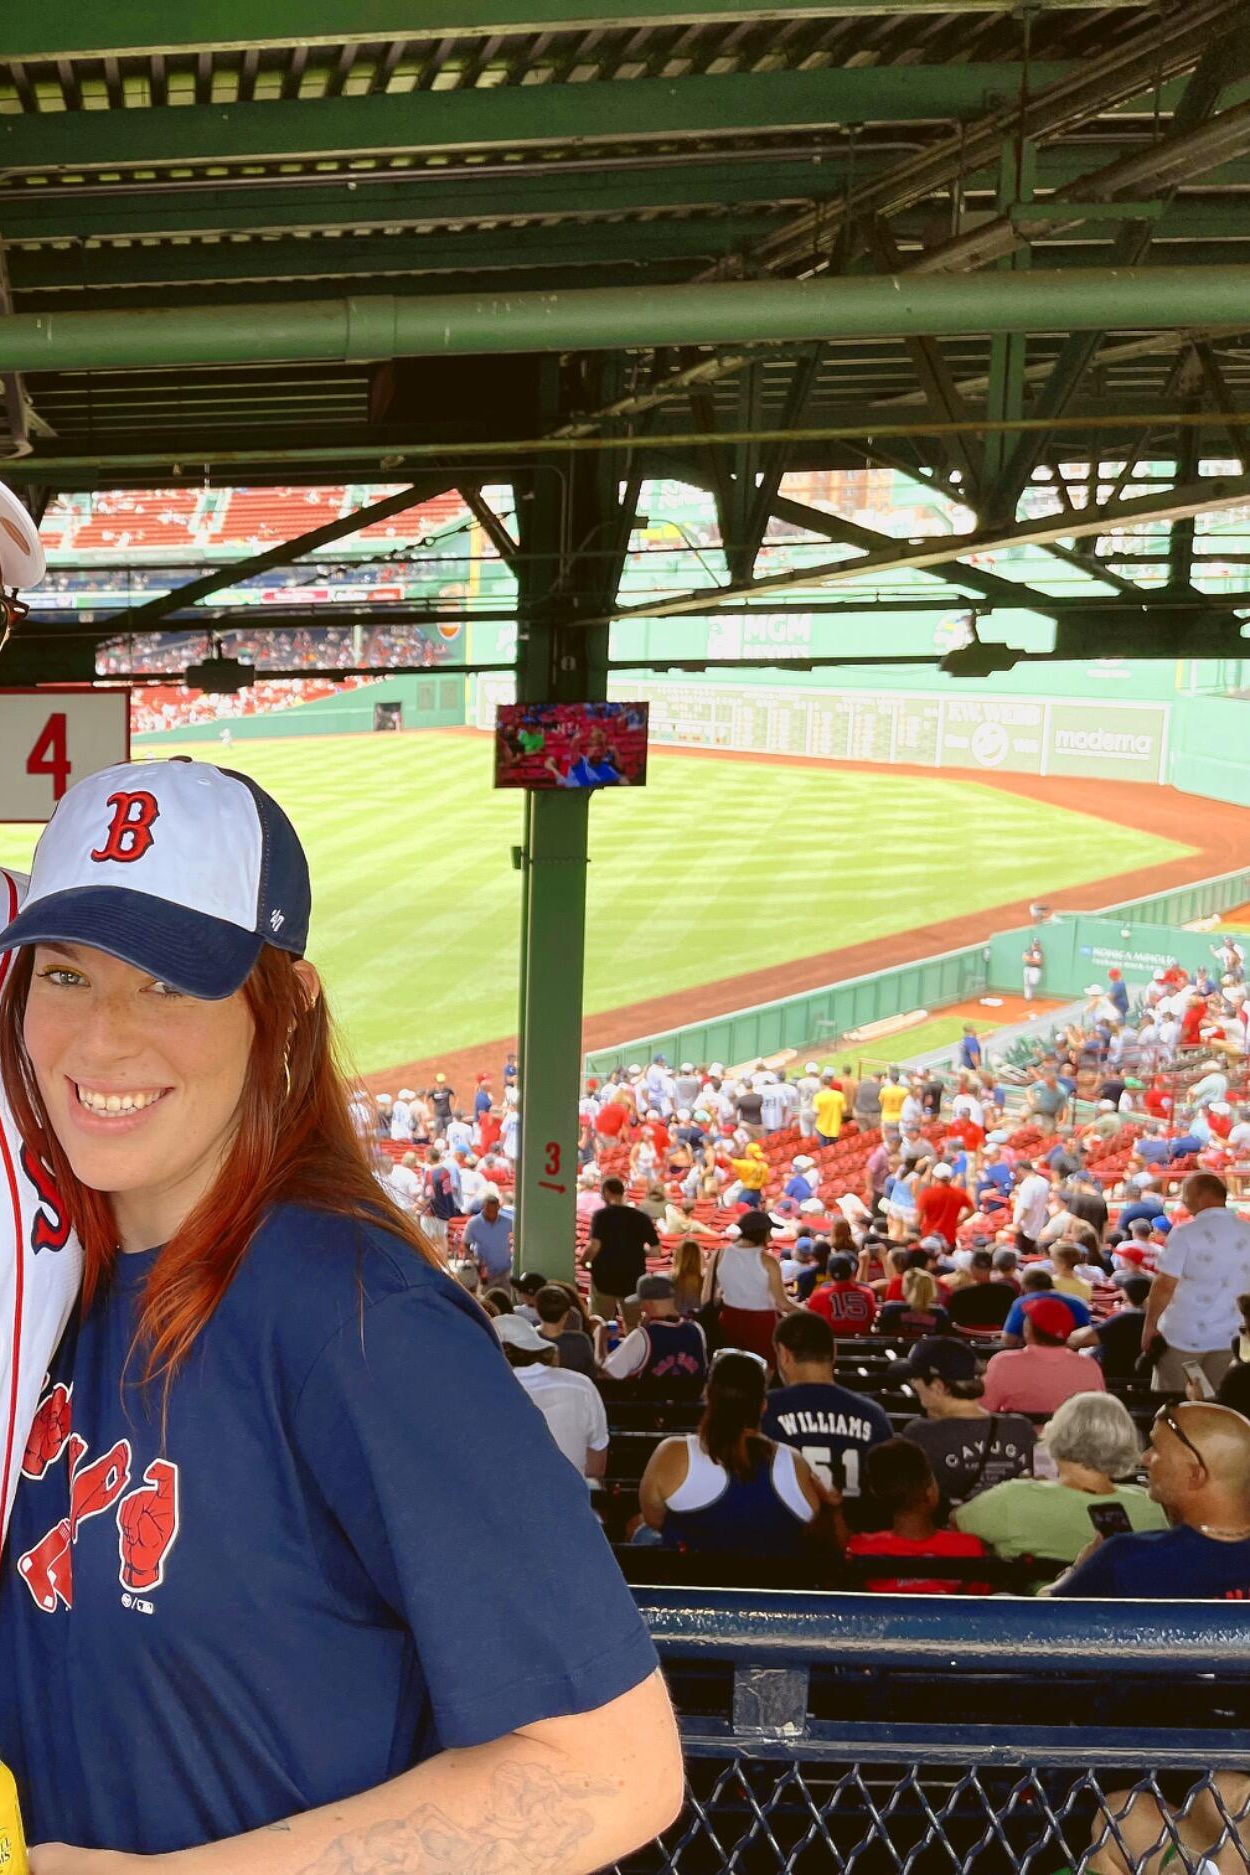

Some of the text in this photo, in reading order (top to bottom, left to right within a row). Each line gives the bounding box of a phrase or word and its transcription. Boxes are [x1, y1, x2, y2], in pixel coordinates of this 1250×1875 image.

[743, 614, 810, 642] MGM
[26, 713, 71, 801] 4
[90, 790, 160, 863] B
[545, 1141, 561, 1176] 3
[830, 1291, 868, 1322] 15
[777, 1410, 873, 1442] WILLIAMS
[801, 1445, 862, 1498] 51
